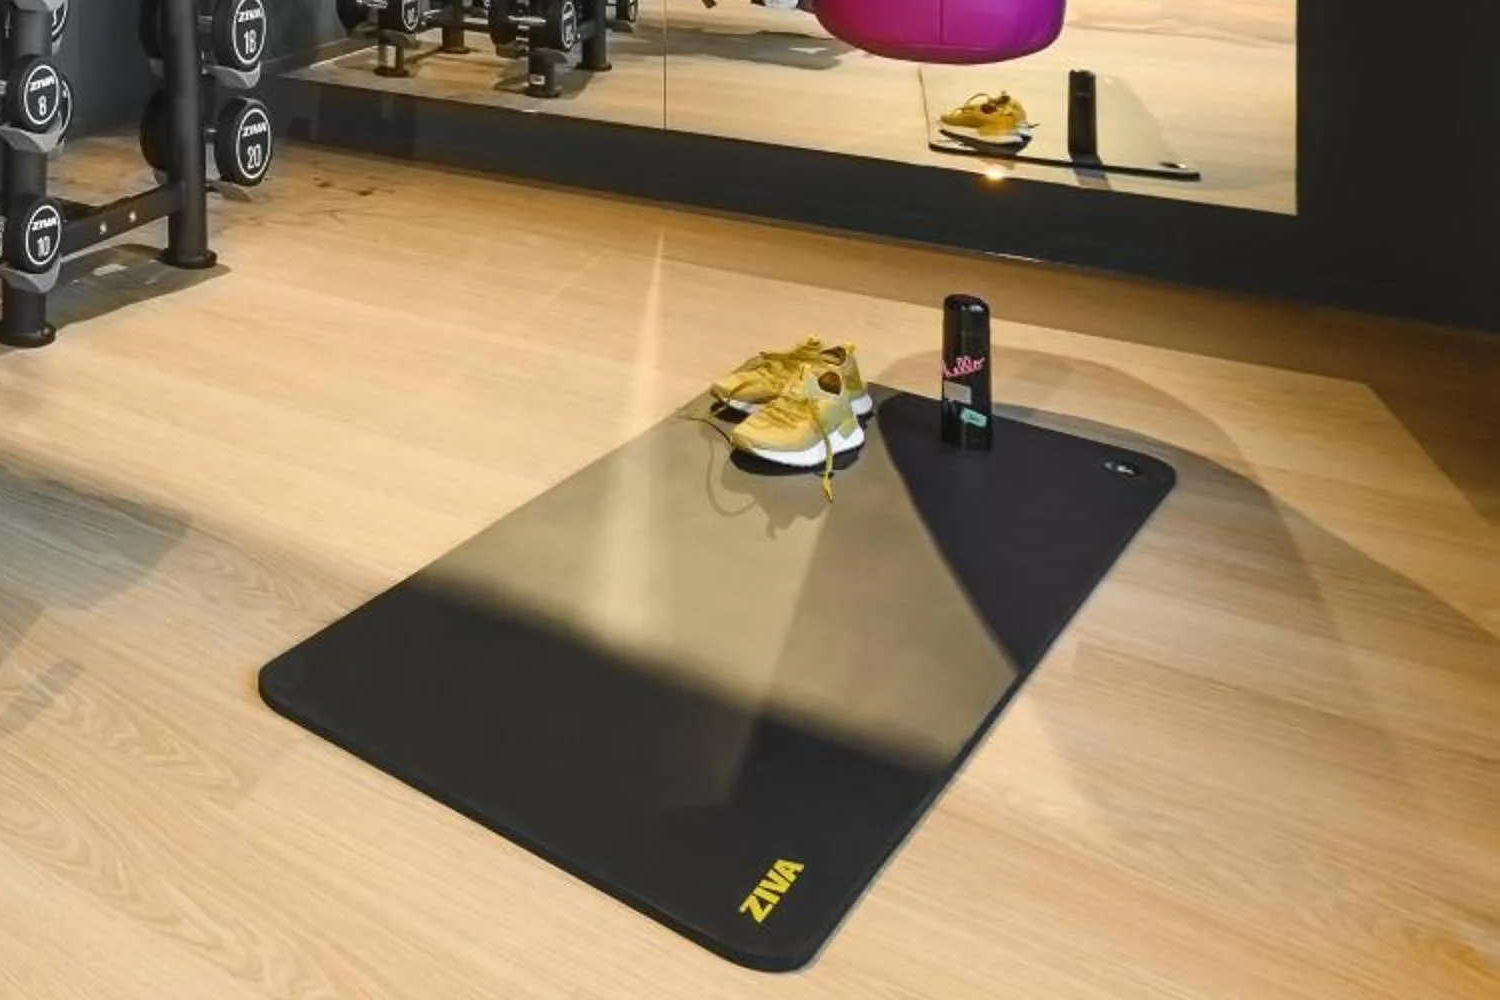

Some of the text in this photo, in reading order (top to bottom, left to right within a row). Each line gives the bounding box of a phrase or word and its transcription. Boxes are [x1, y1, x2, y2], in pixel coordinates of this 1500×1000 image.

[243, 28, 258, 55] 18
[37, 94, 48, 117] 8
[246, 142, 262, 170] 20
[36, 234, 52, 258] 10
[739, 859, 805, 923] ZIVA
